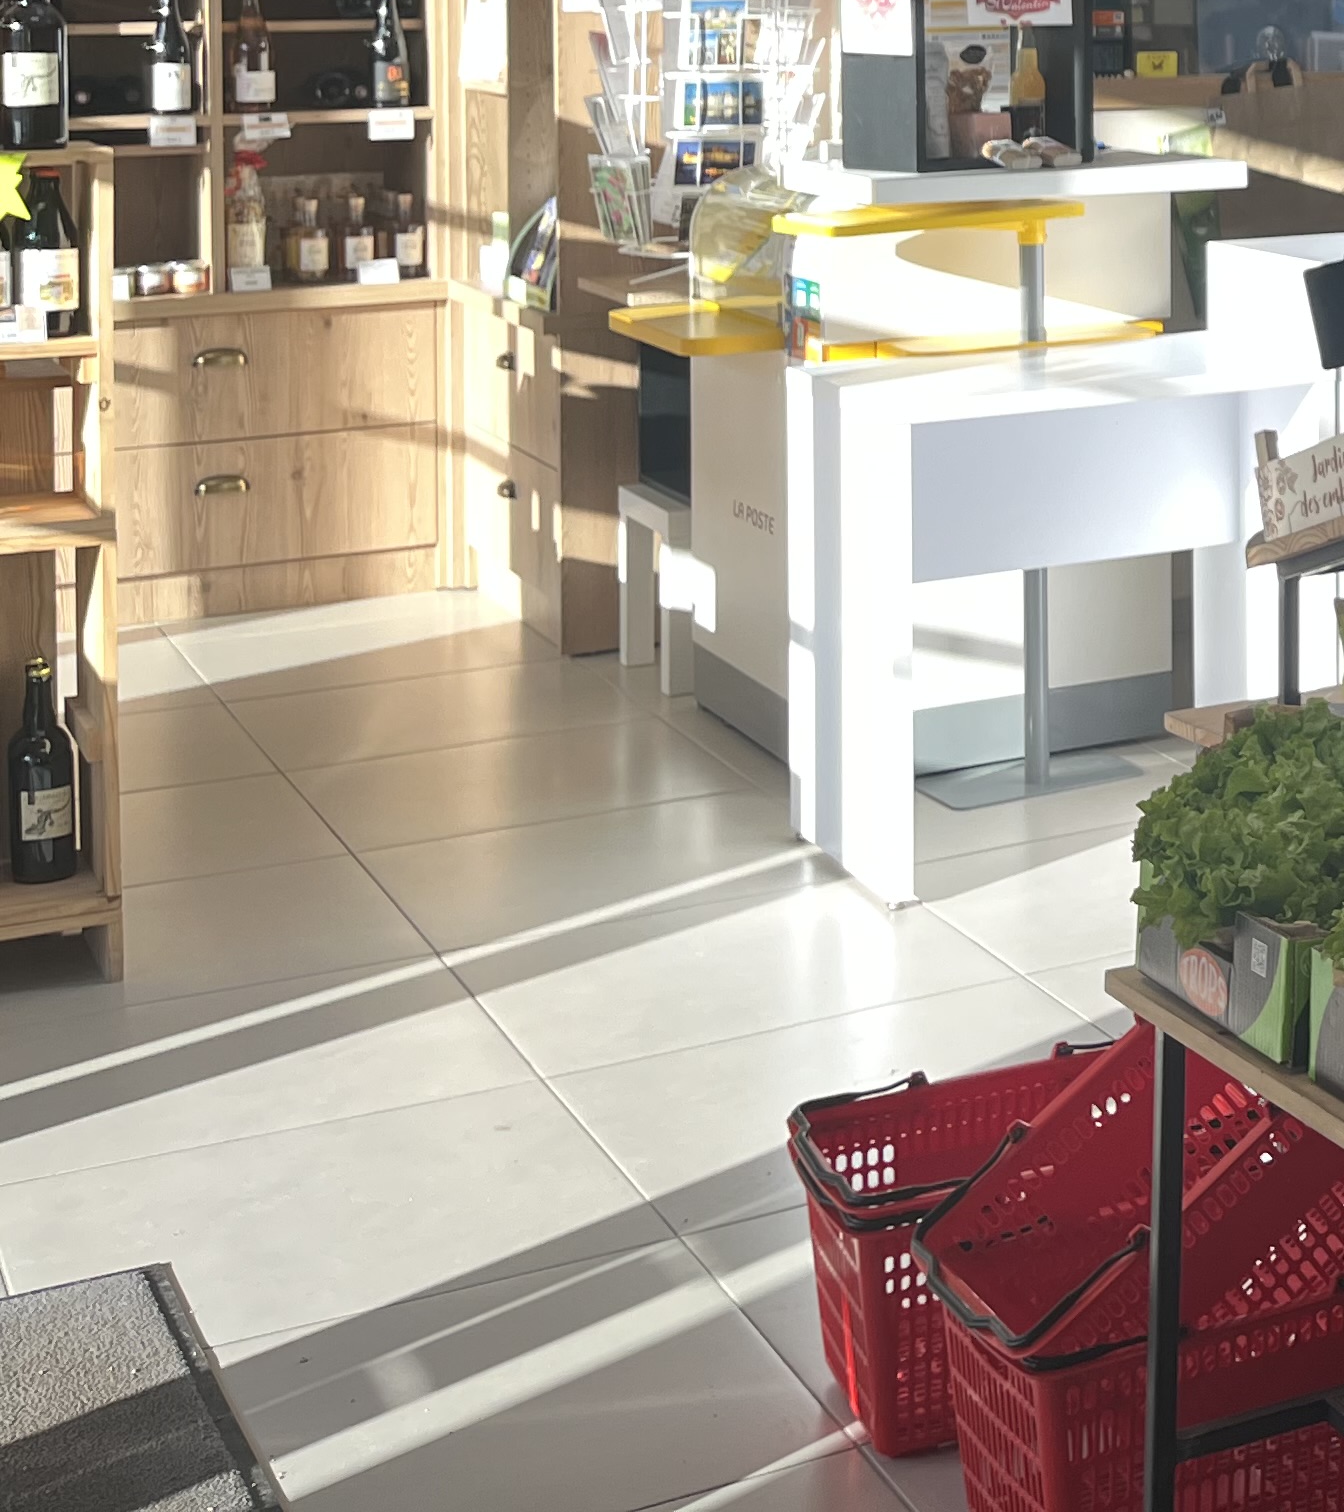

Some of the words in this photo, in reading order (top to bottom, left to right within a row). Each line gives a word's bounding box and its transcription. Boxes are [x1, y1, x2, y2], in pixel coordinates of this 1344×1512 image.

[733, 499, 744, 519] LA
[746, 505, 775, 535] POSTE
[1182, 952, 1227, 1010] TROPS
